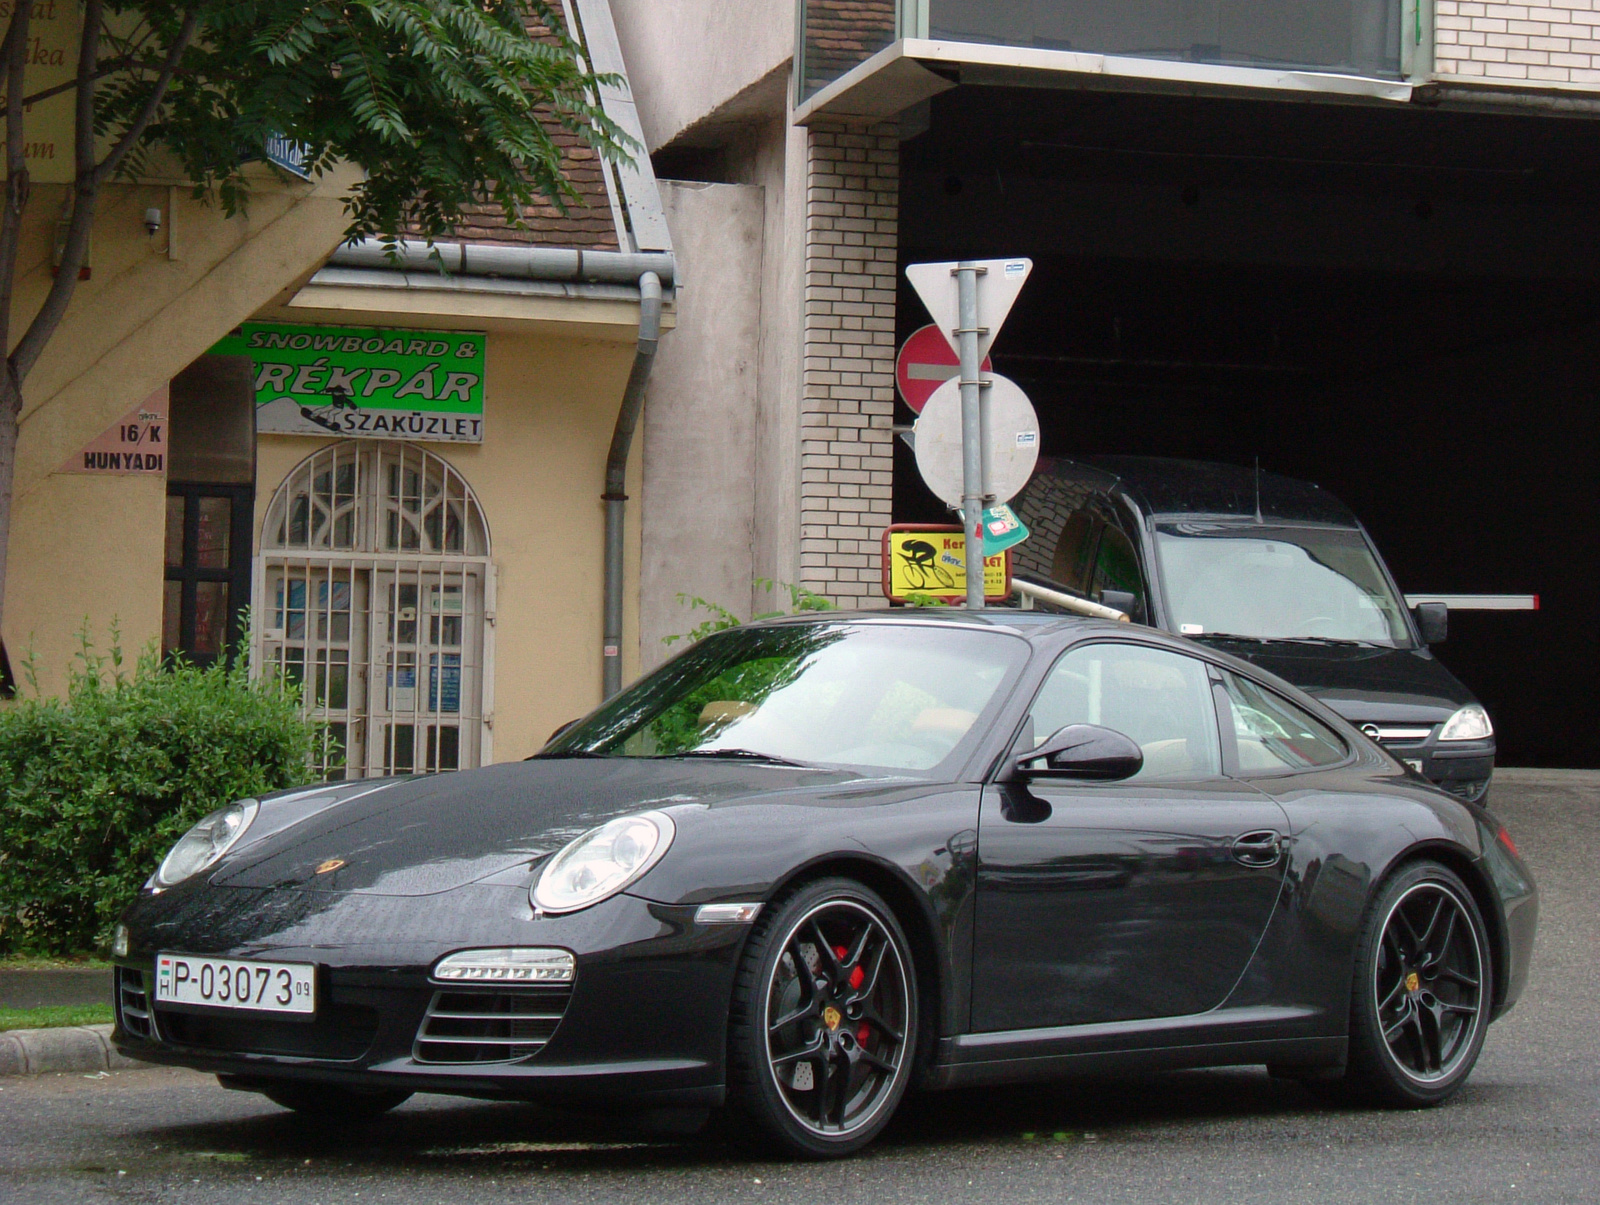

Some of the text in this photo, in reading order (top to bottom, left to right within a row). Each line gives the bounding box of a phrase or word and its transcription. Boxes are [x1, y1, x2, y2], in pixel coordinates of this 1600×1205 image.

[247, 330, 479, 359] SNOWBOARD &
[252, 357, 480, 402] RÉKPÁR
[120, 421, 161, 446] 16/K
[343, 411, 481, 436] SZAKÜZLET
[83, 451, 163, 471] HUNYADI
[159, 961, 310, 1006] H P-03073 09
